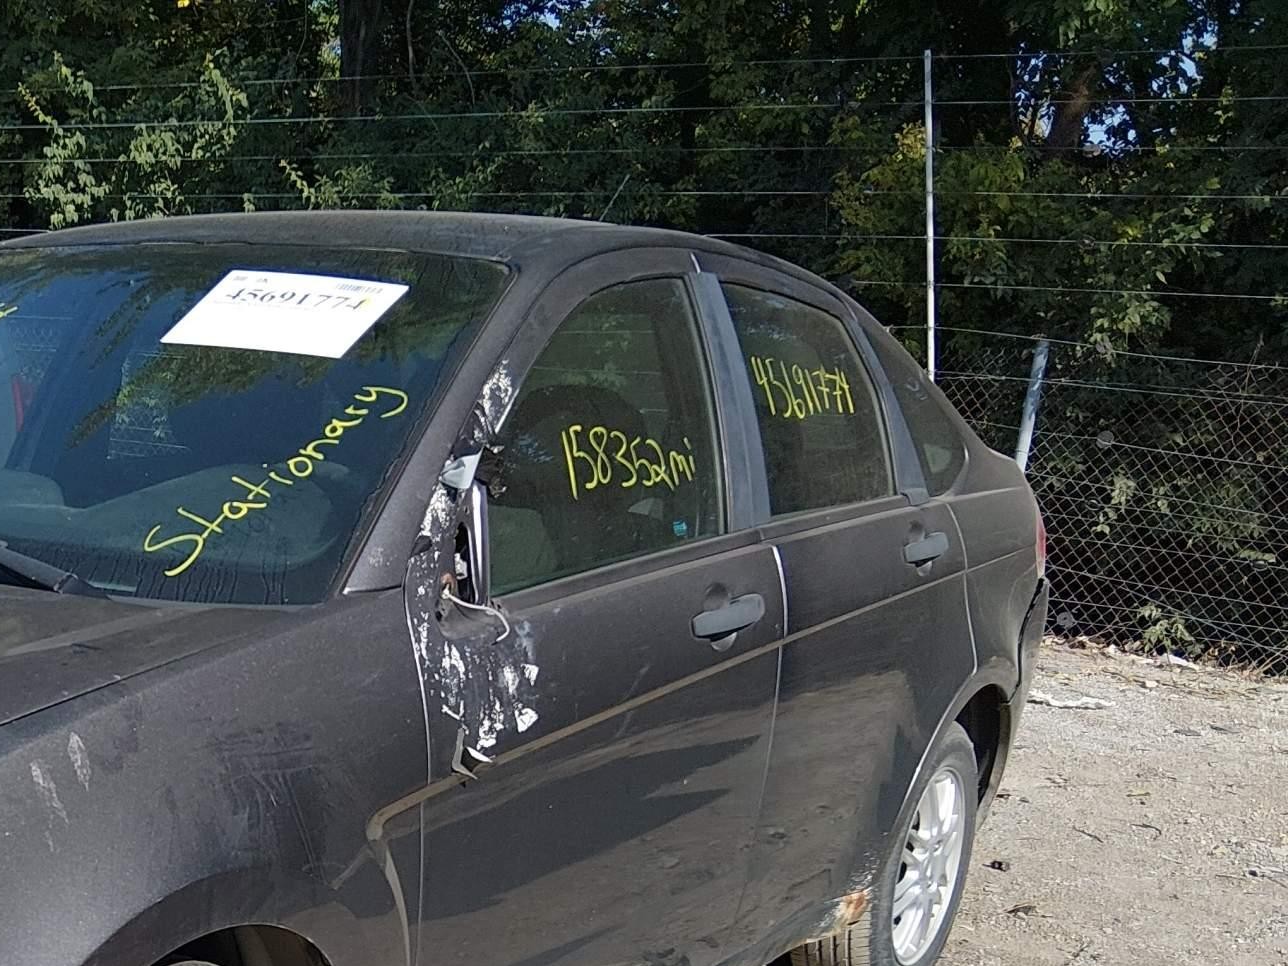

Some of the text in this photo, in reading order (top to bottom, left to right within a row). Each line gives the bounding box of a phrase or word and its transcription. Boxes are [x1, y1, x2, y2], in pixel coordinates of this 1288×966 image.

[225, 286, 367, 311] 45691774
[750, 356, 854, 419] 45691774
[143, 386, 408, 577] Stationary
